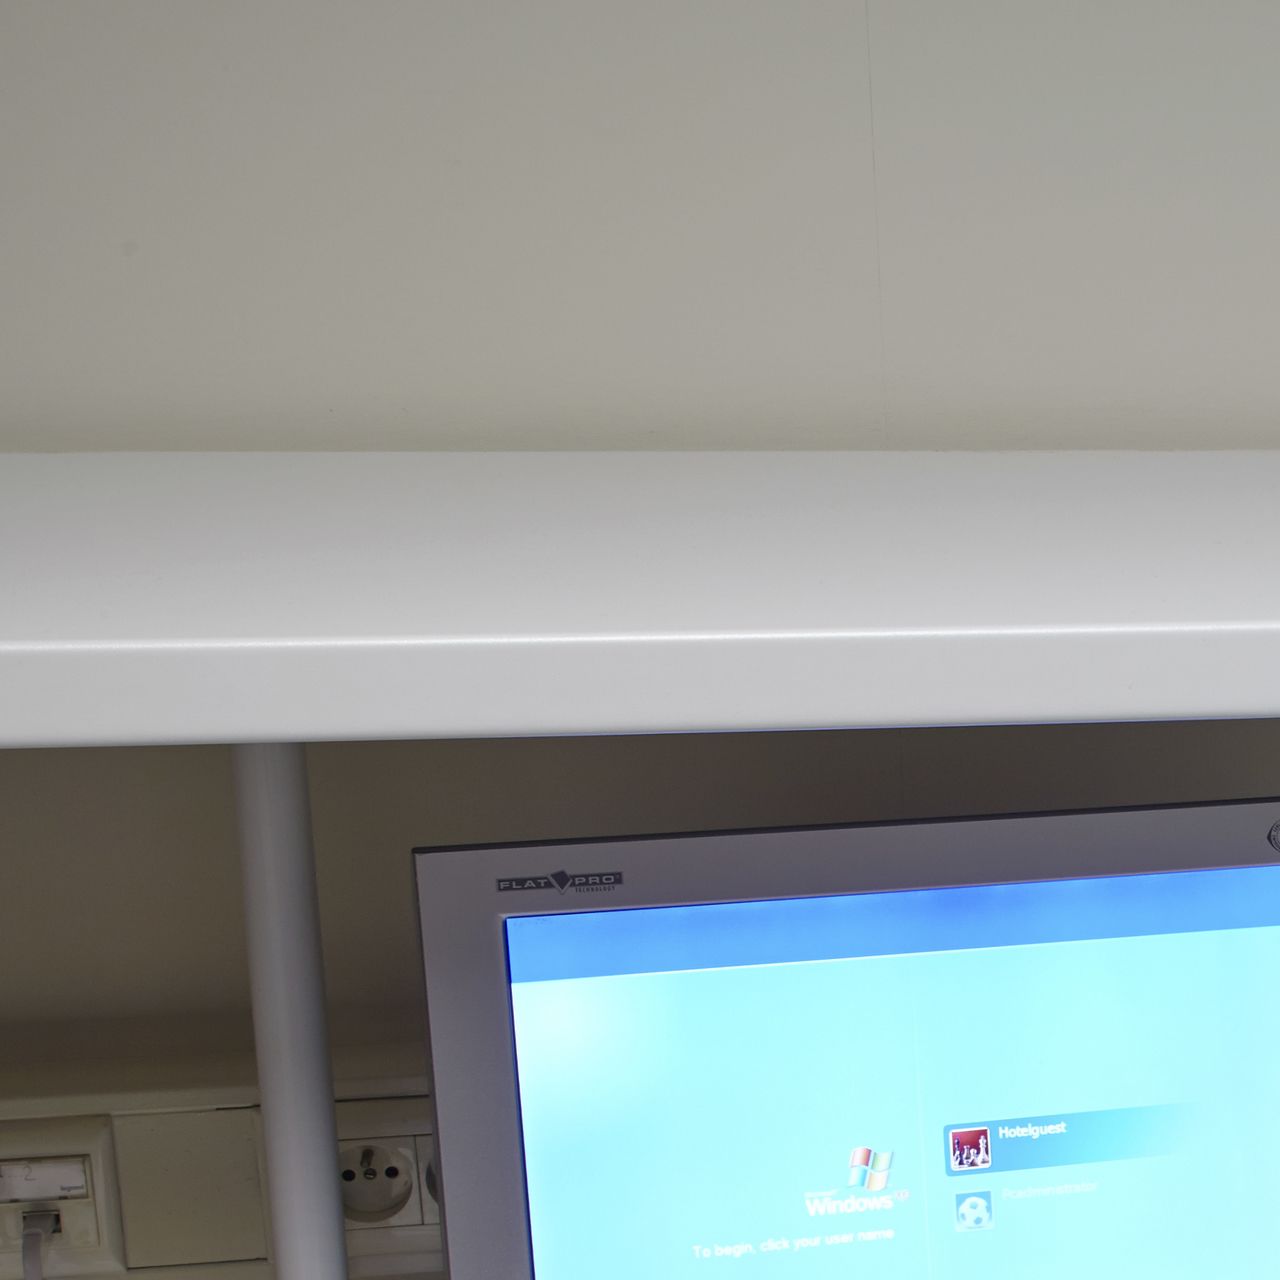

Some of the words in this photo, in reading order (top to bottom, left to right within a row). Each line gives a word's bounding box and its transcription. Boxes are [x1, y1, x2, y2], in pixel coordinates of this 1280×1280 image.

[499, 878, 548, 890] FLAT
[574, 874, 616, 885] PRO
[998, 1121, 1067, 1139] Hotelguest
[804, 1193, 894, 1217] Windows
[692, 1245, 711, 1258] To
[714, 1241, 756, 1258] begin,
[760, 1237, 790, 1251] click
[794, 1235, 821, 1251] your
[825, 1232, 854, 1245] user
[858, 1228, 895, 1242] name
